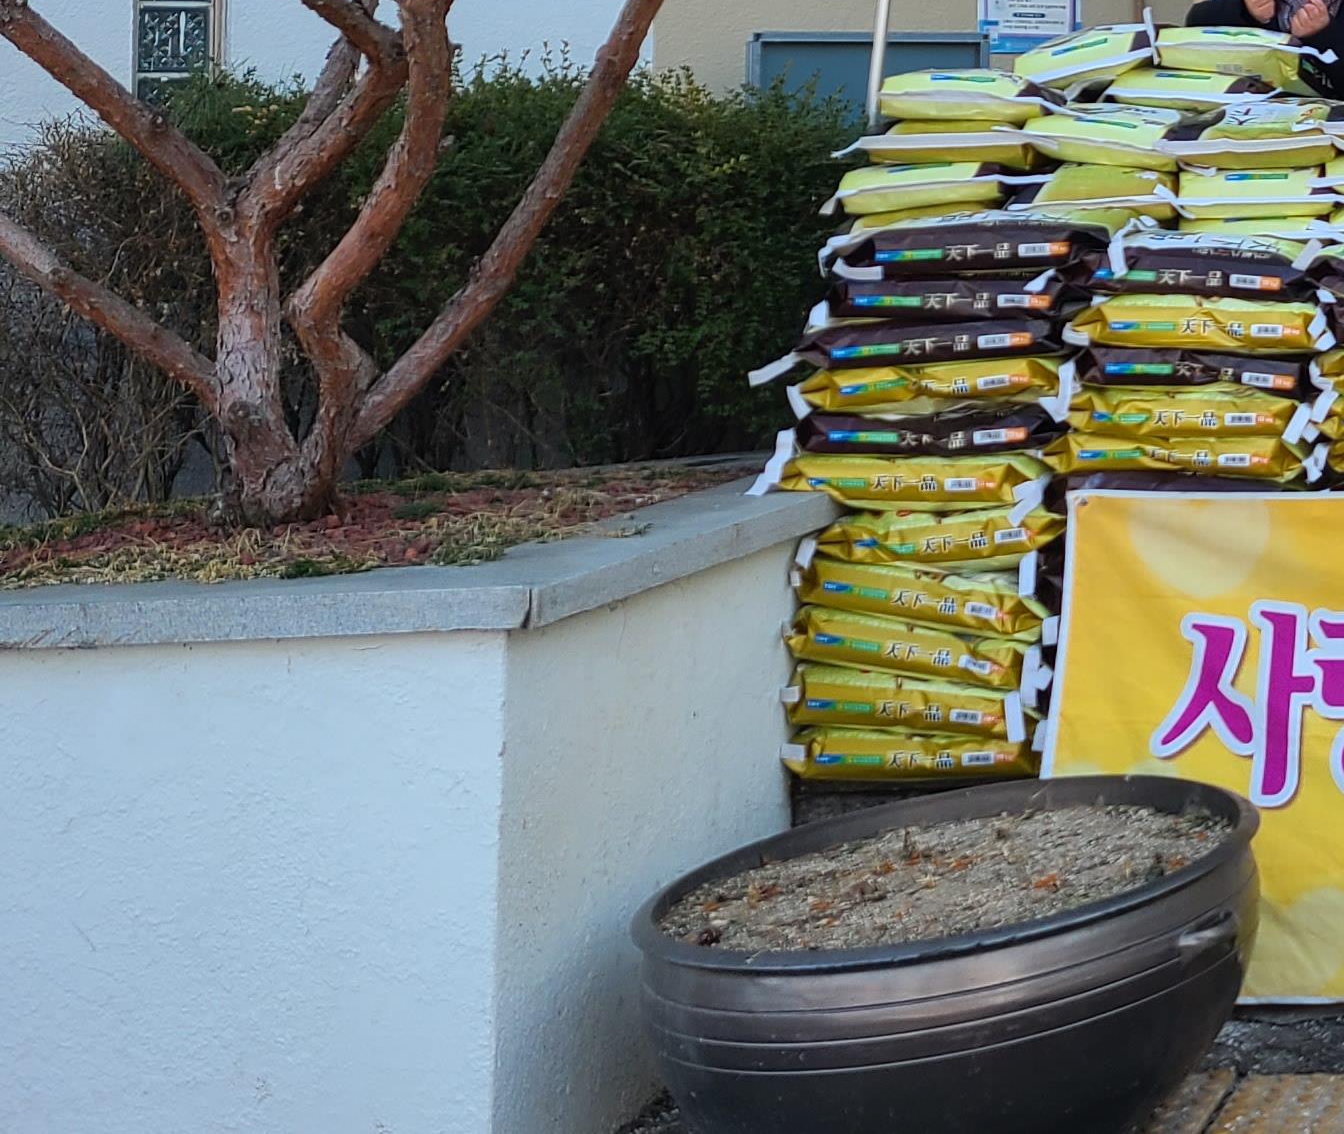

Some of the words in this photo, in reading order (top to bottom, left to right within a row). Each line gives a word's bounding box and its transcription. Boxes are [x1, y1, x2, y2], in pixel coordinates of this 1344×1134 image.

[944, 242, 1011, 261] 天下一品
[1157, 268, 1223, 287] 天下一品
[923, 292, 991, 310] 天下一品
[902, 334, 970, 356] 天下一品
[1153, 409, 1219, 429] 天下一品
[871, 473, 938, 492] 天下一品
[921, 530, 989, 554] 天下一品
[891, 589, 957, 615] 天下一品
[885, 642, 952, 666] 天下一品
[878, 702, 942, 723] 天下一品
[887, 749, 954, 770] 天下一品
